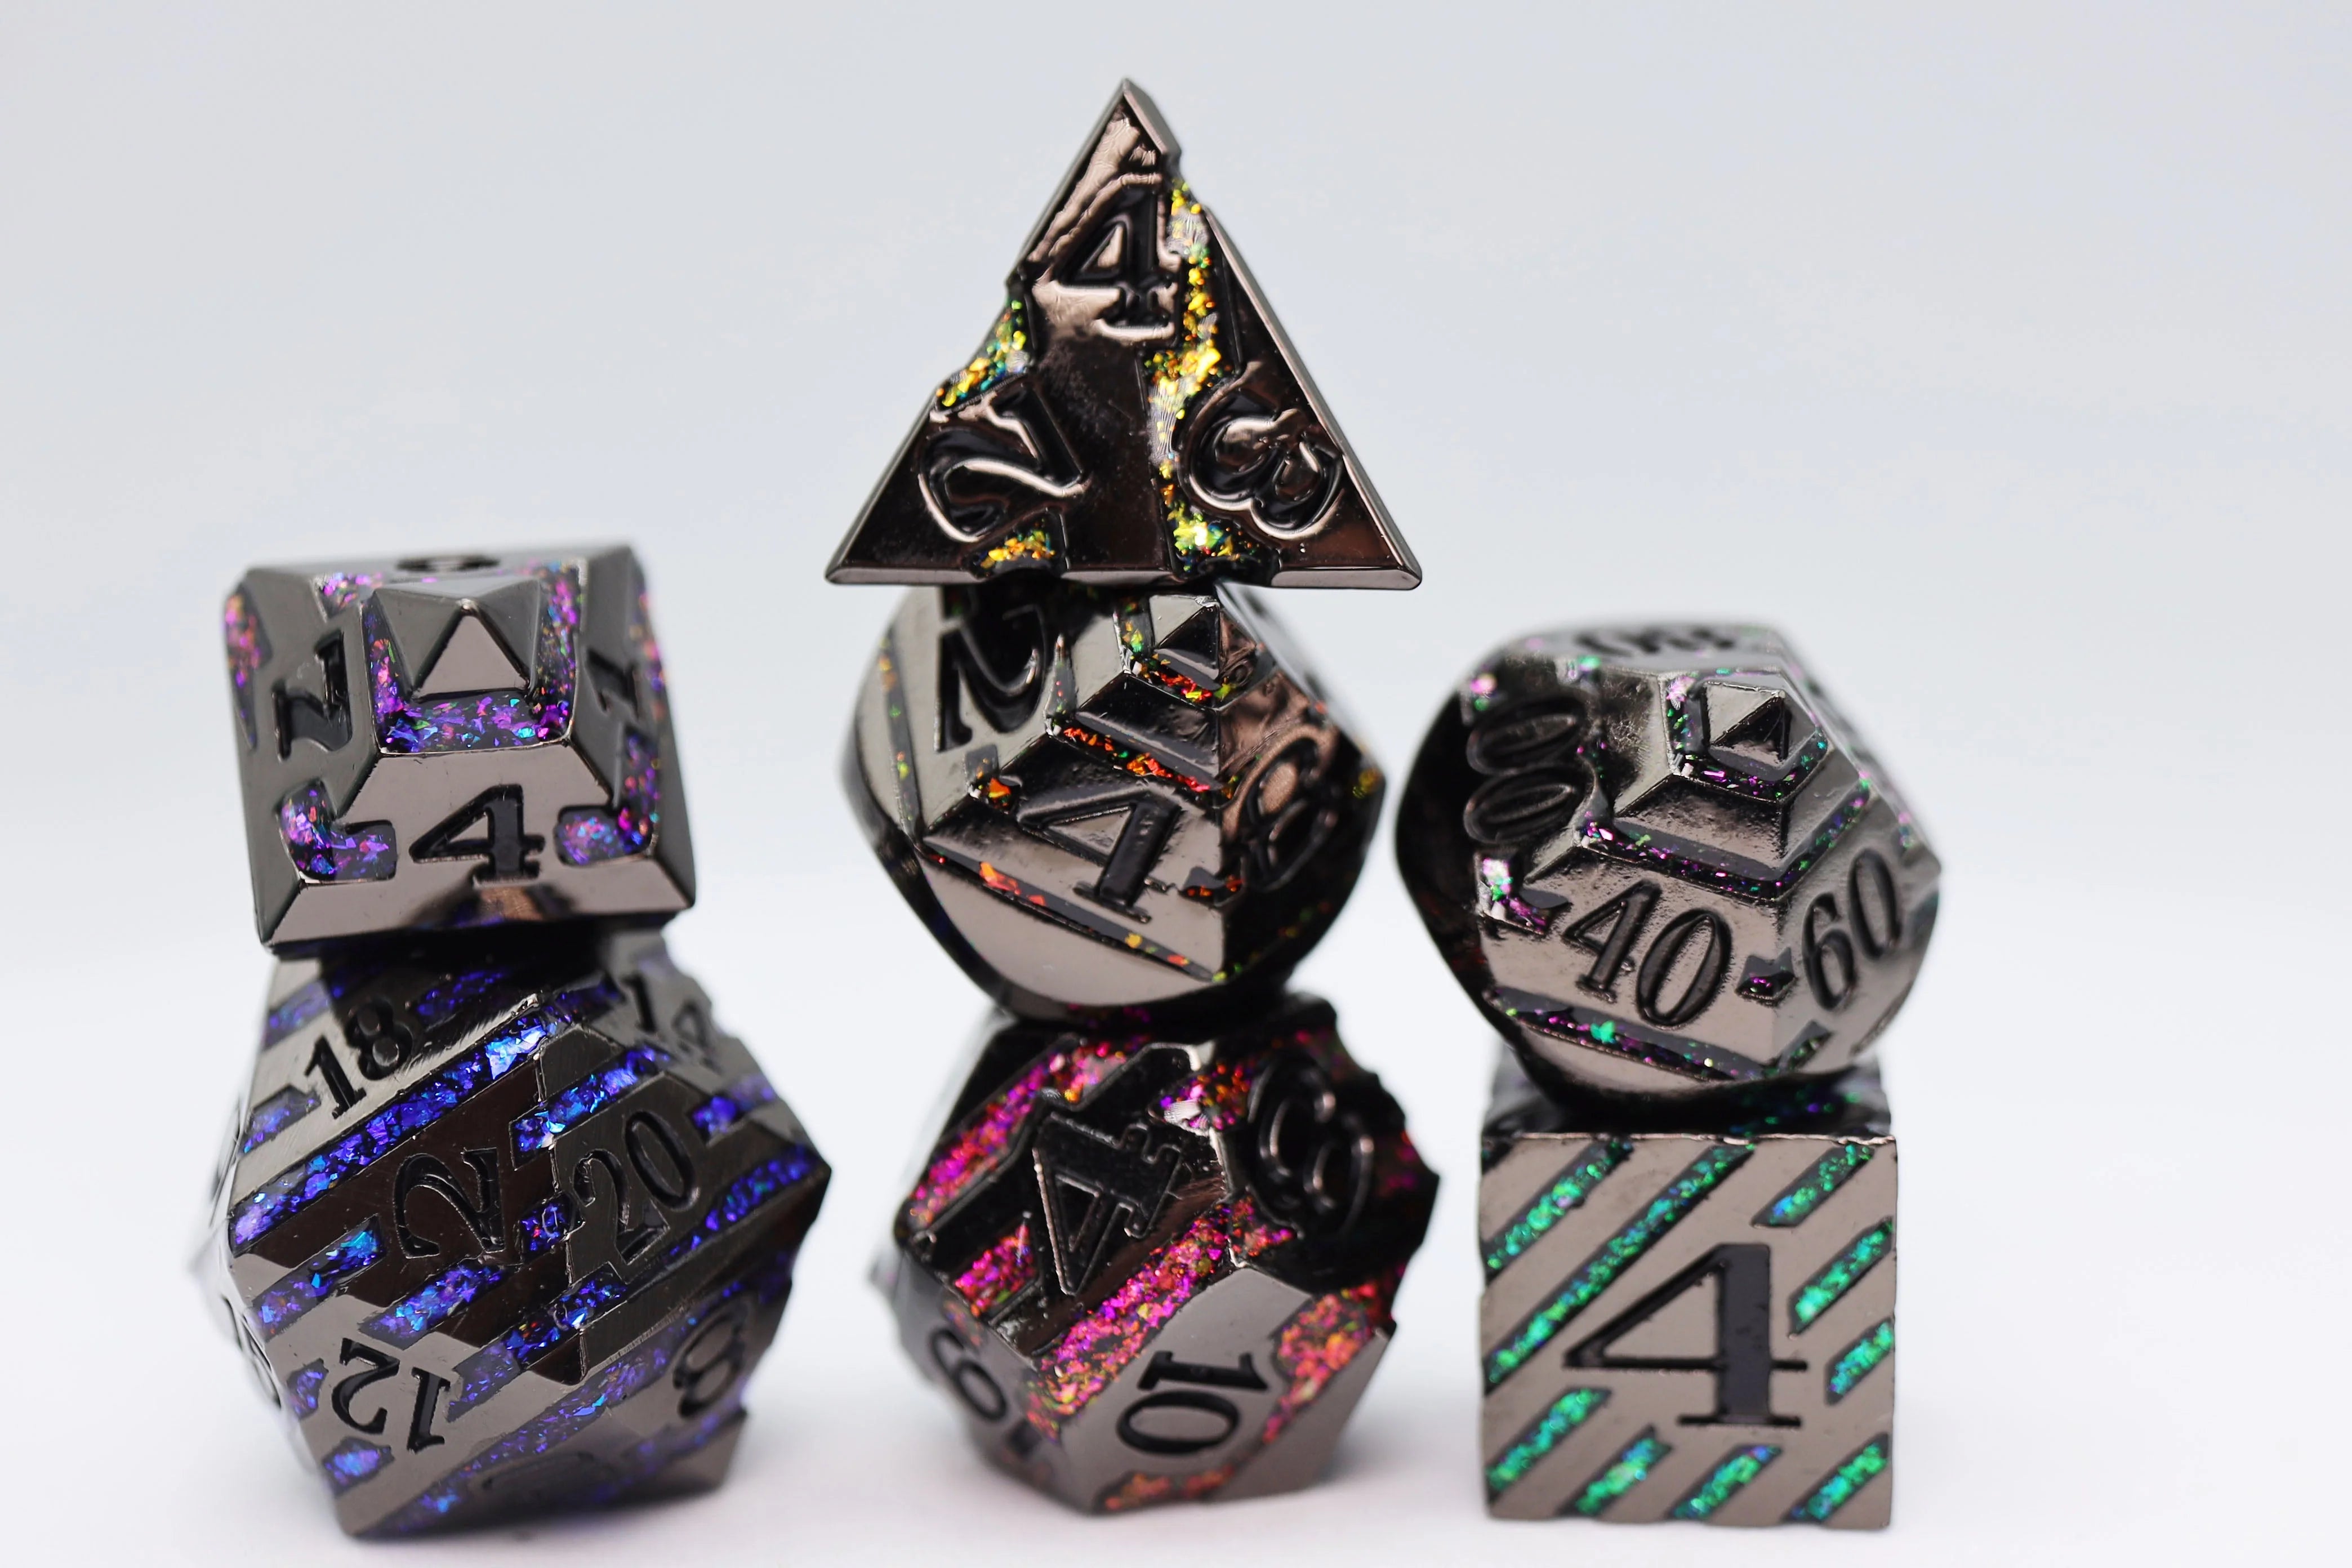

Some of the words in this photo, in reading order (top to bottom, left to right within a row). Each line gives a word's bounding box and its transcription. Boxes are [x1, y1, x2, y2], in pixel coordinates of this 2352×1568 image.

[1052, 179, 1178, 337] 4
[919, 380, 1088, 540] 2
[1178, 389, 1343, 538] 3
[409, 784, 545, 882] 4
[1018, 790, 1182, 923] 4
[1561, 881, 1732, 1028] 40
[1802, 849, 1902, 1008] 60
[305, 998, 412, 1120] 18
[394, 1147, 505, 1258] 2
[572, 1111, 700, 1265] 20
[1032, 1112, 1184, 1297] 4
[331, 1337, 452, 1454] 12
[1117, 1352, 1268, 1455] 10
[1562, 1243, 1808, 1427] 4
